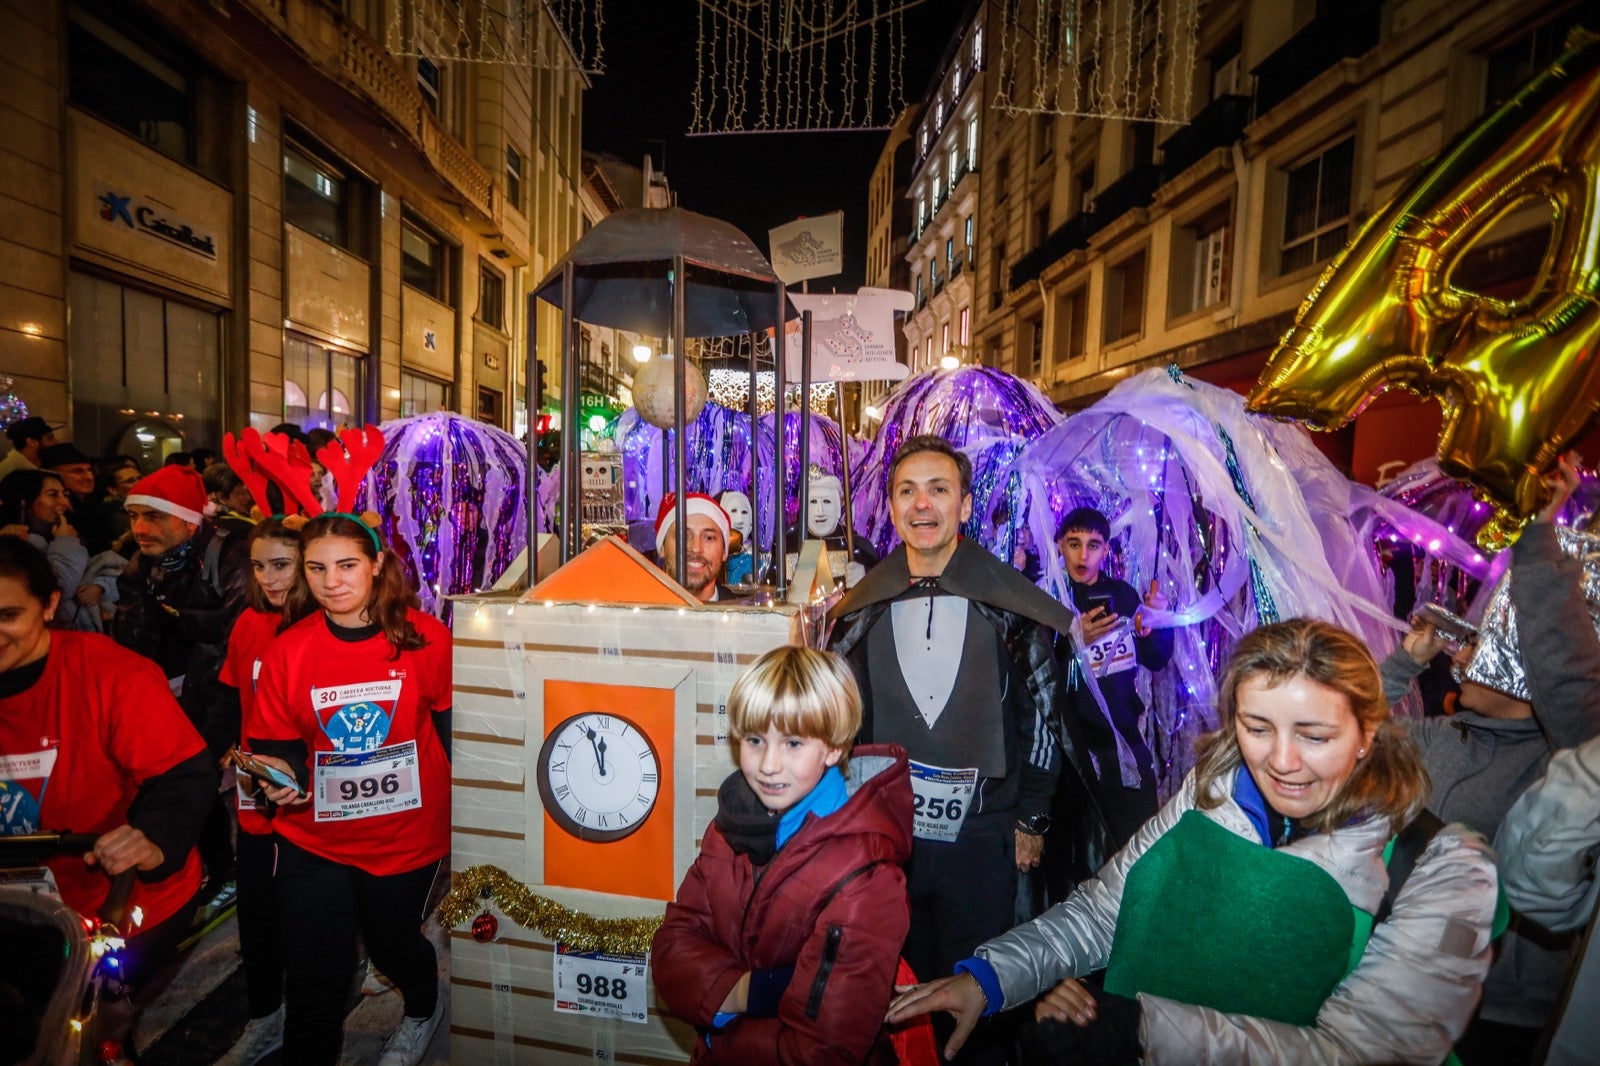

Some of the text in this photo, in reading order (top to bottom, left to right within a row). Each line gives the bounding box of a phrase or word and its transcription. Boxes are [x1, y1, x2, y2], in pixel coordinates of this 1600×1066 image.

[320, 690, 337, 704] 30
[365, 685, 392, 693] NOCTURNA
[597, 716, 610, 729] XII
[339, 773, 400, 801] 996
[642, 773, 657, 783] III
[913, 793, 962, 821] 256
[576, 973, 628, 1000] 988
